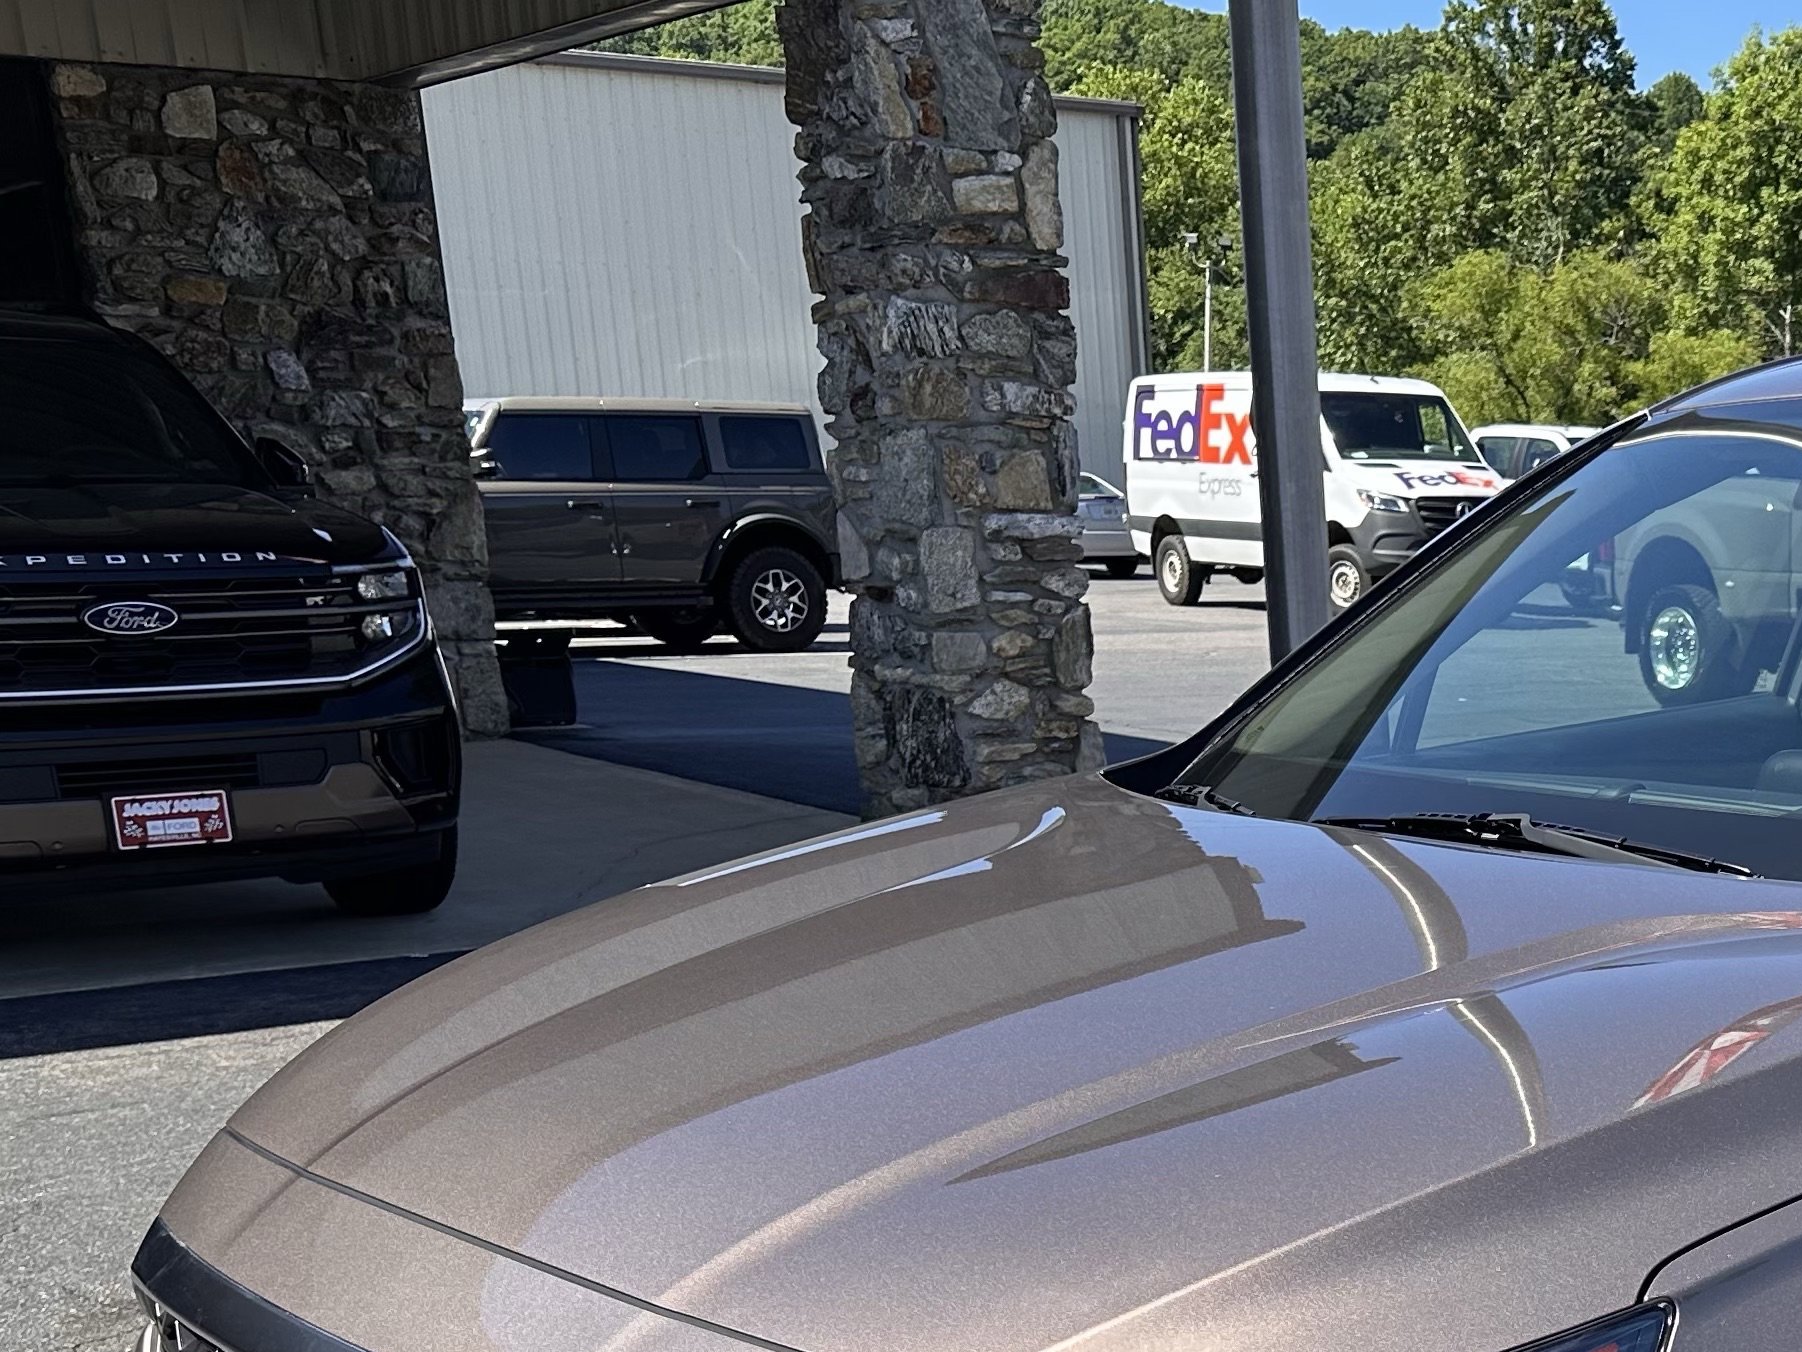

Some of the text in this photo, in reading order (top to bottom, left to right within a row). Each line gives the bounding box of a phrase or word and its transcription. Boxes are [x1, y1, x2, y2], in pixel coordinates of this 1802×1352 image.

[1133, 383, 1252, 464] FedEx
[1199, 472, 1241, 498] Express
[1392, 470, 1500, 490] FedEx
[103, 606, 163, 629] Ford
